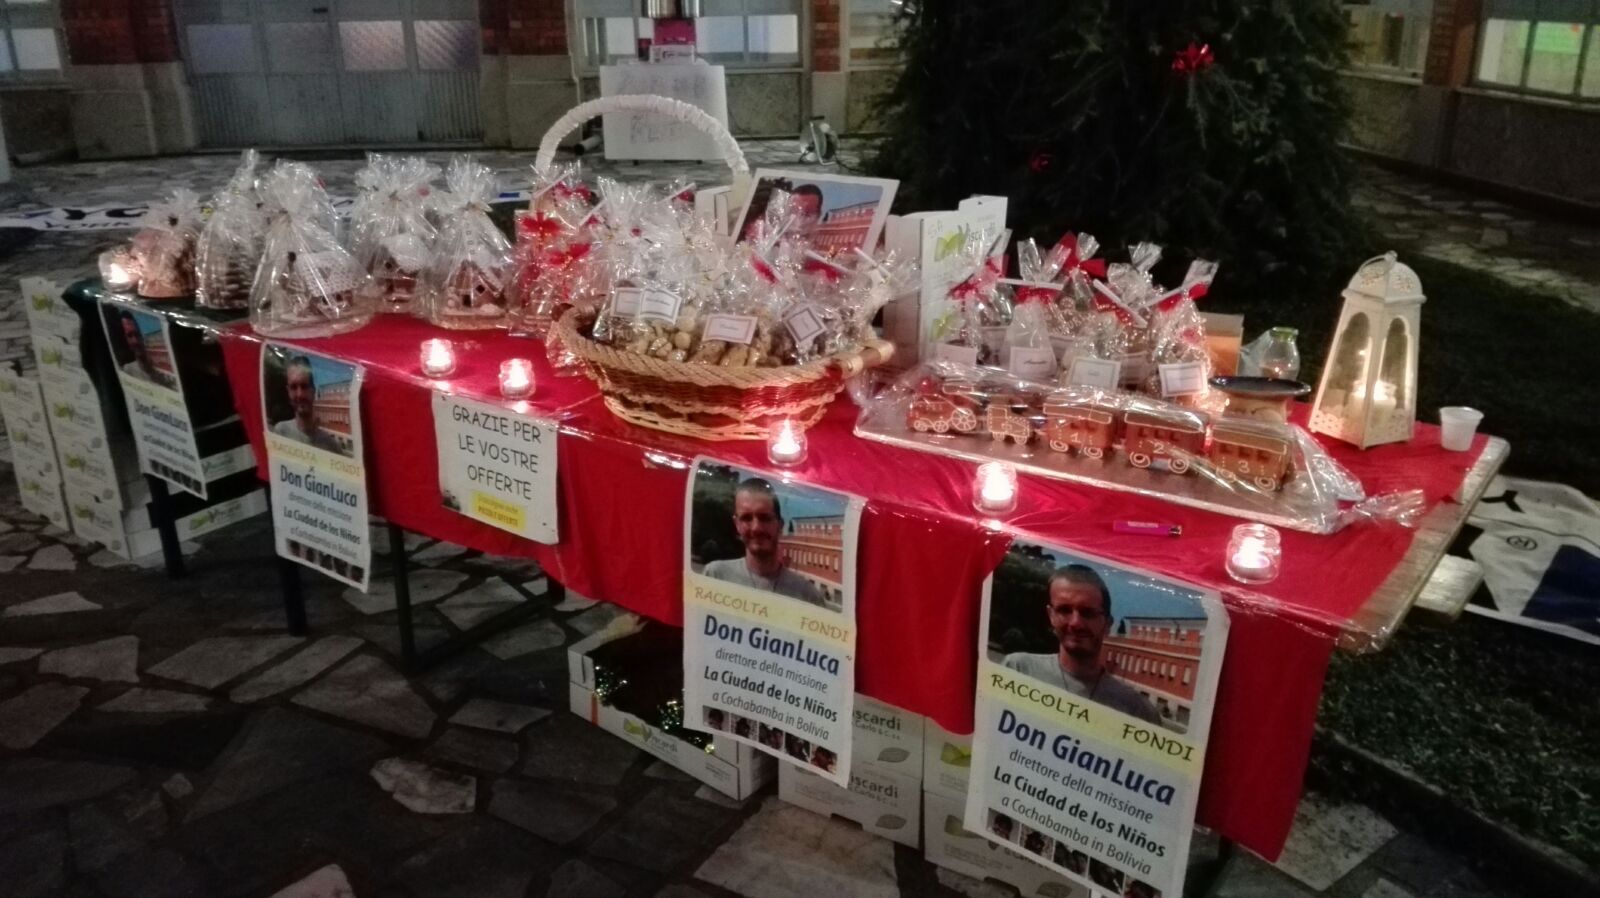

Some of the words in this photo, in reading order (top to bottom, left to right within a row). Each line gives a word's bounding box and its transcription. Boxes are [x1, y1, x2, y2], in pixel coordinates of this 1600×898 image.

[452, 404, 509, 436] GRAZIE
[513, 420, 542, 444] PER
[458, 433, 475, 454] LE
[478, 439, 538, 474] VOSTRE
[1153, 443, 1164, 454] 2
[1238, 460, 1249, 473] 3
[280, 464, 302, 488] Don
[304, 473, 358, 508] GianLuca
[467, 464, 532, 500] OFFERTE
[694, 586, 769, 618] RACCOLTA
[800, 616, 849, 643] FONDI
[703, 614, 743, 644] Don
[748, 627, 840, 676] GianLuca
[703, 665, 718, 682] La
[721, 670, 765, 695] Ciudad
[766, 684, 782, 701] de
[784, 689, 801, 708] los
[803, 696, 838, 723] Niños
[715, 647, 757, 670] direttore
[759, 658, 783, 677] della
[785, 669, 828, 694] missione
[712, 691, 719, 703] a
[721, 691, 784, 723] Cochabamba
[785, 711, 795, 724] in
[796, 716, 830, 741] Bolivia
[852, 709, 901, 731] iscardi
[991, 673, 1090, 723] RACCOLTA
[1122, 723, 1195, 762] FONDI
[997, 709, 1046, 751] Don
[1052, 734, 1176, 806] GianLuca
[849, 773, 899, 799] iscardi
[1009, 749, 1061, 782] direttore
[1061, 767, 1093, 798] della
[1095, 789, 1154, 824] missione
[993, 766, 1012, 785] La
[1014, 775, 1066, 812] Ciudad
[1068, 795, 1090, 821] de
[1090, 810, 1114, 834] los
[1117, 823, 1166, 858] Niños
[1001, 797, 1010, 807] a
[1011, 797, 1089, 846] Cochabamba
[1090, 834, 1105, 851] in
[1106, 845, 1152, 876] Bolivia
